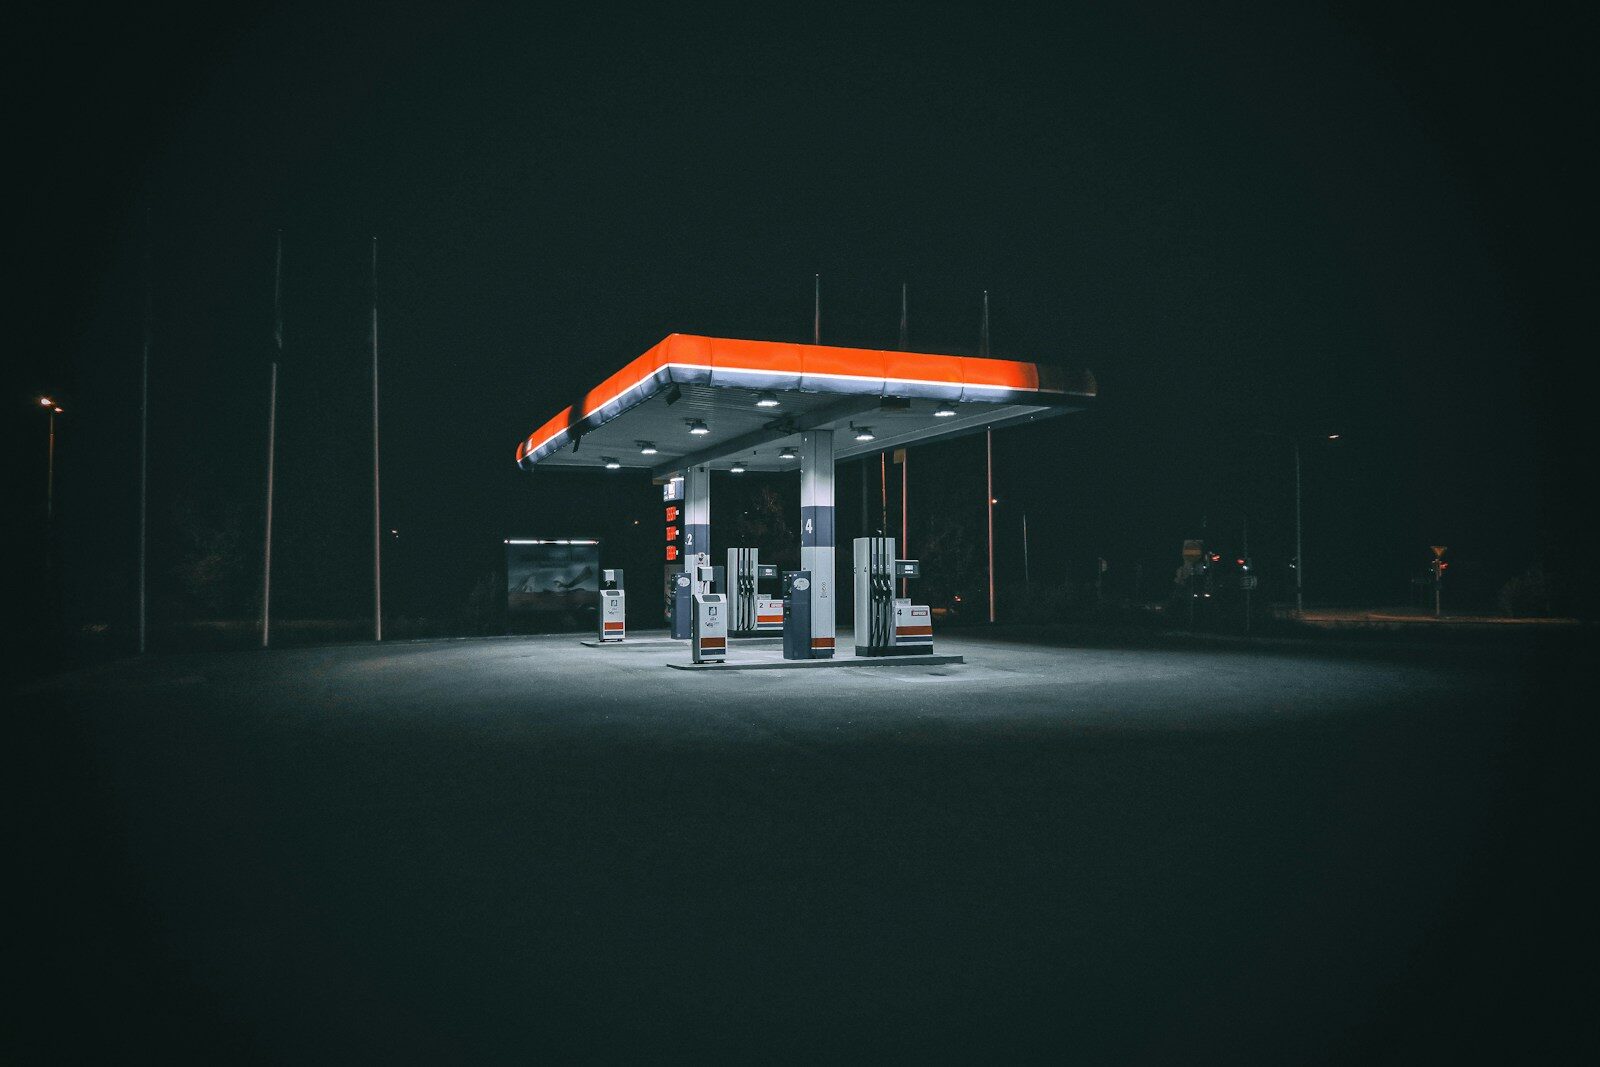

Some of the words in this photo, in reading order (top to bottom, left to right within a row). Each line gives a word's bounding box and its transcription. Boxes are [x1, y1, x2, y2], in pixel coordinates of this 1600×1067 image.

[805, 518, 813, 534] 4
[687, 533, 693, 546] 2
[897, 608, 903, 616] 4
